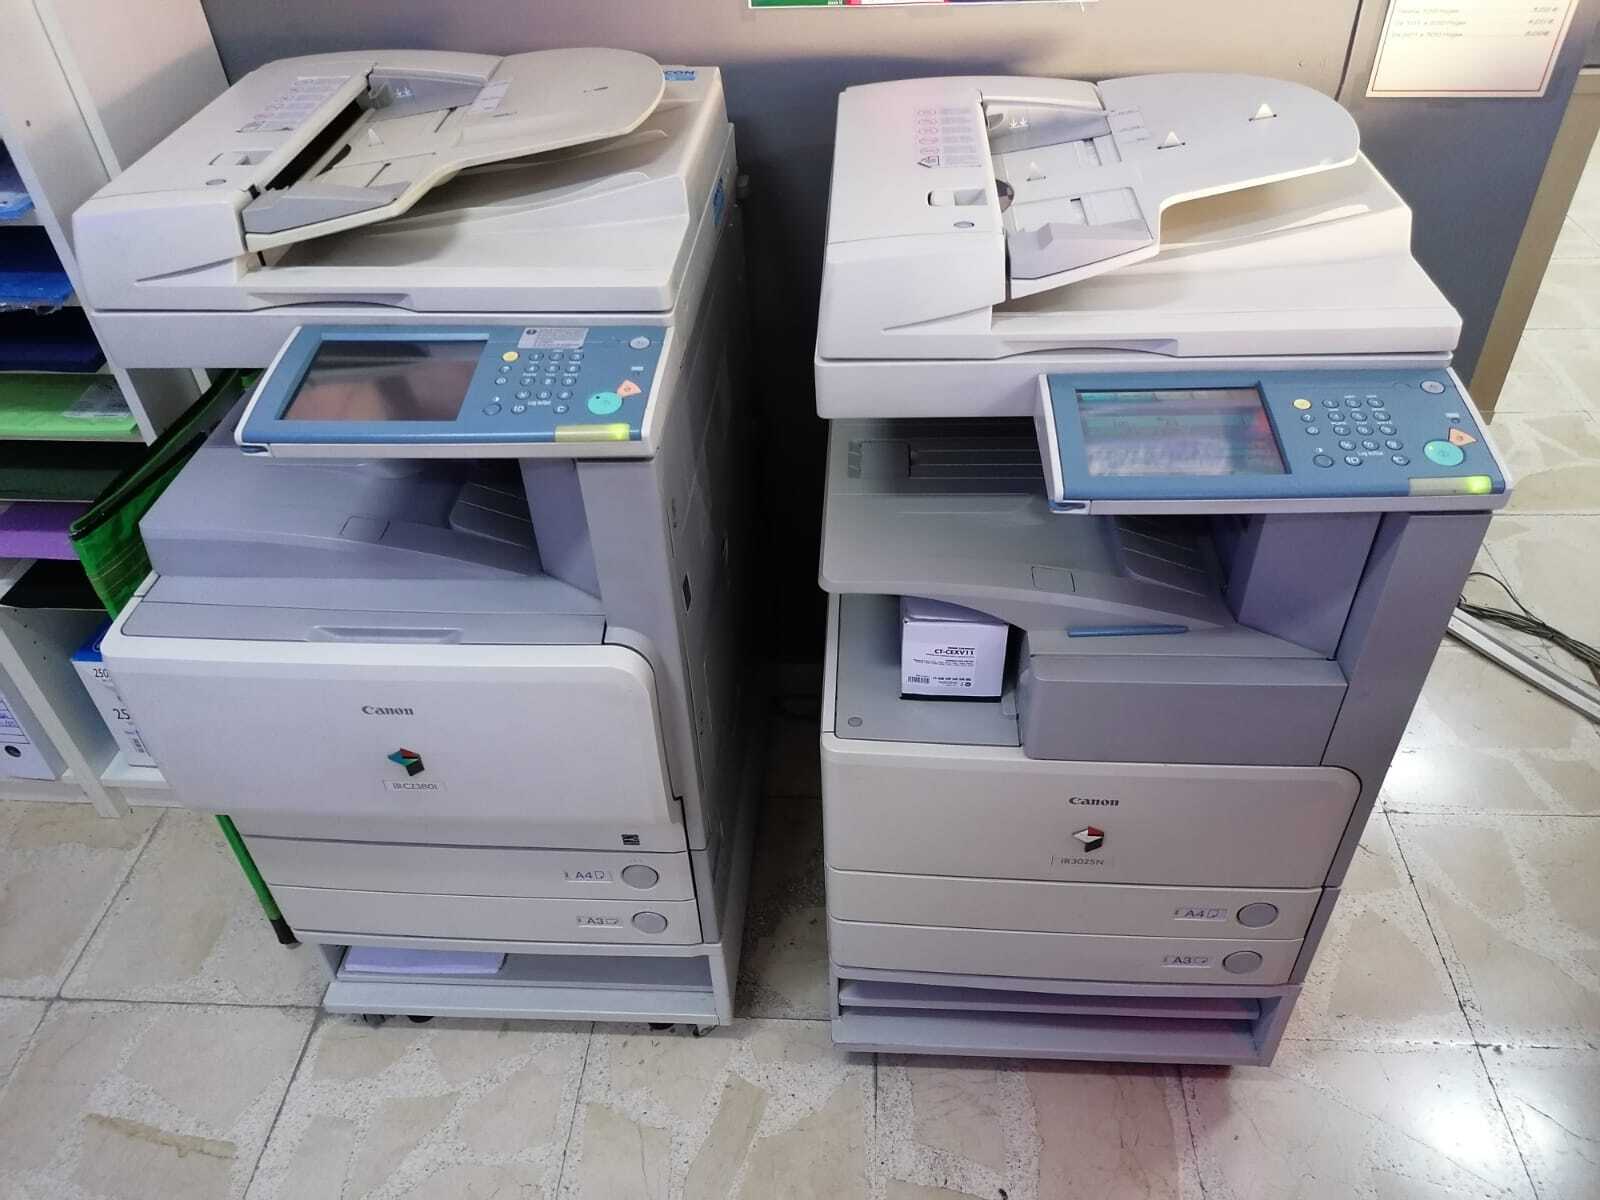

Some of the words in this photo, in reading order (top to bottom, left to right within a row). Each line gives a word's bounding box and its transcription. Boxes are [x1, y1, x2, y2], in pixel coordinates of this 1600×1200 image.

[361, 705, 415, 716] Canon
[1068, 796, 1120, 807] Canon
[575, 871, 593, 880] A4
[1184, 909, 1204, 918] A4
[587, 916, 604, 925] A3
[1172, 955, 1192, 965] A3
